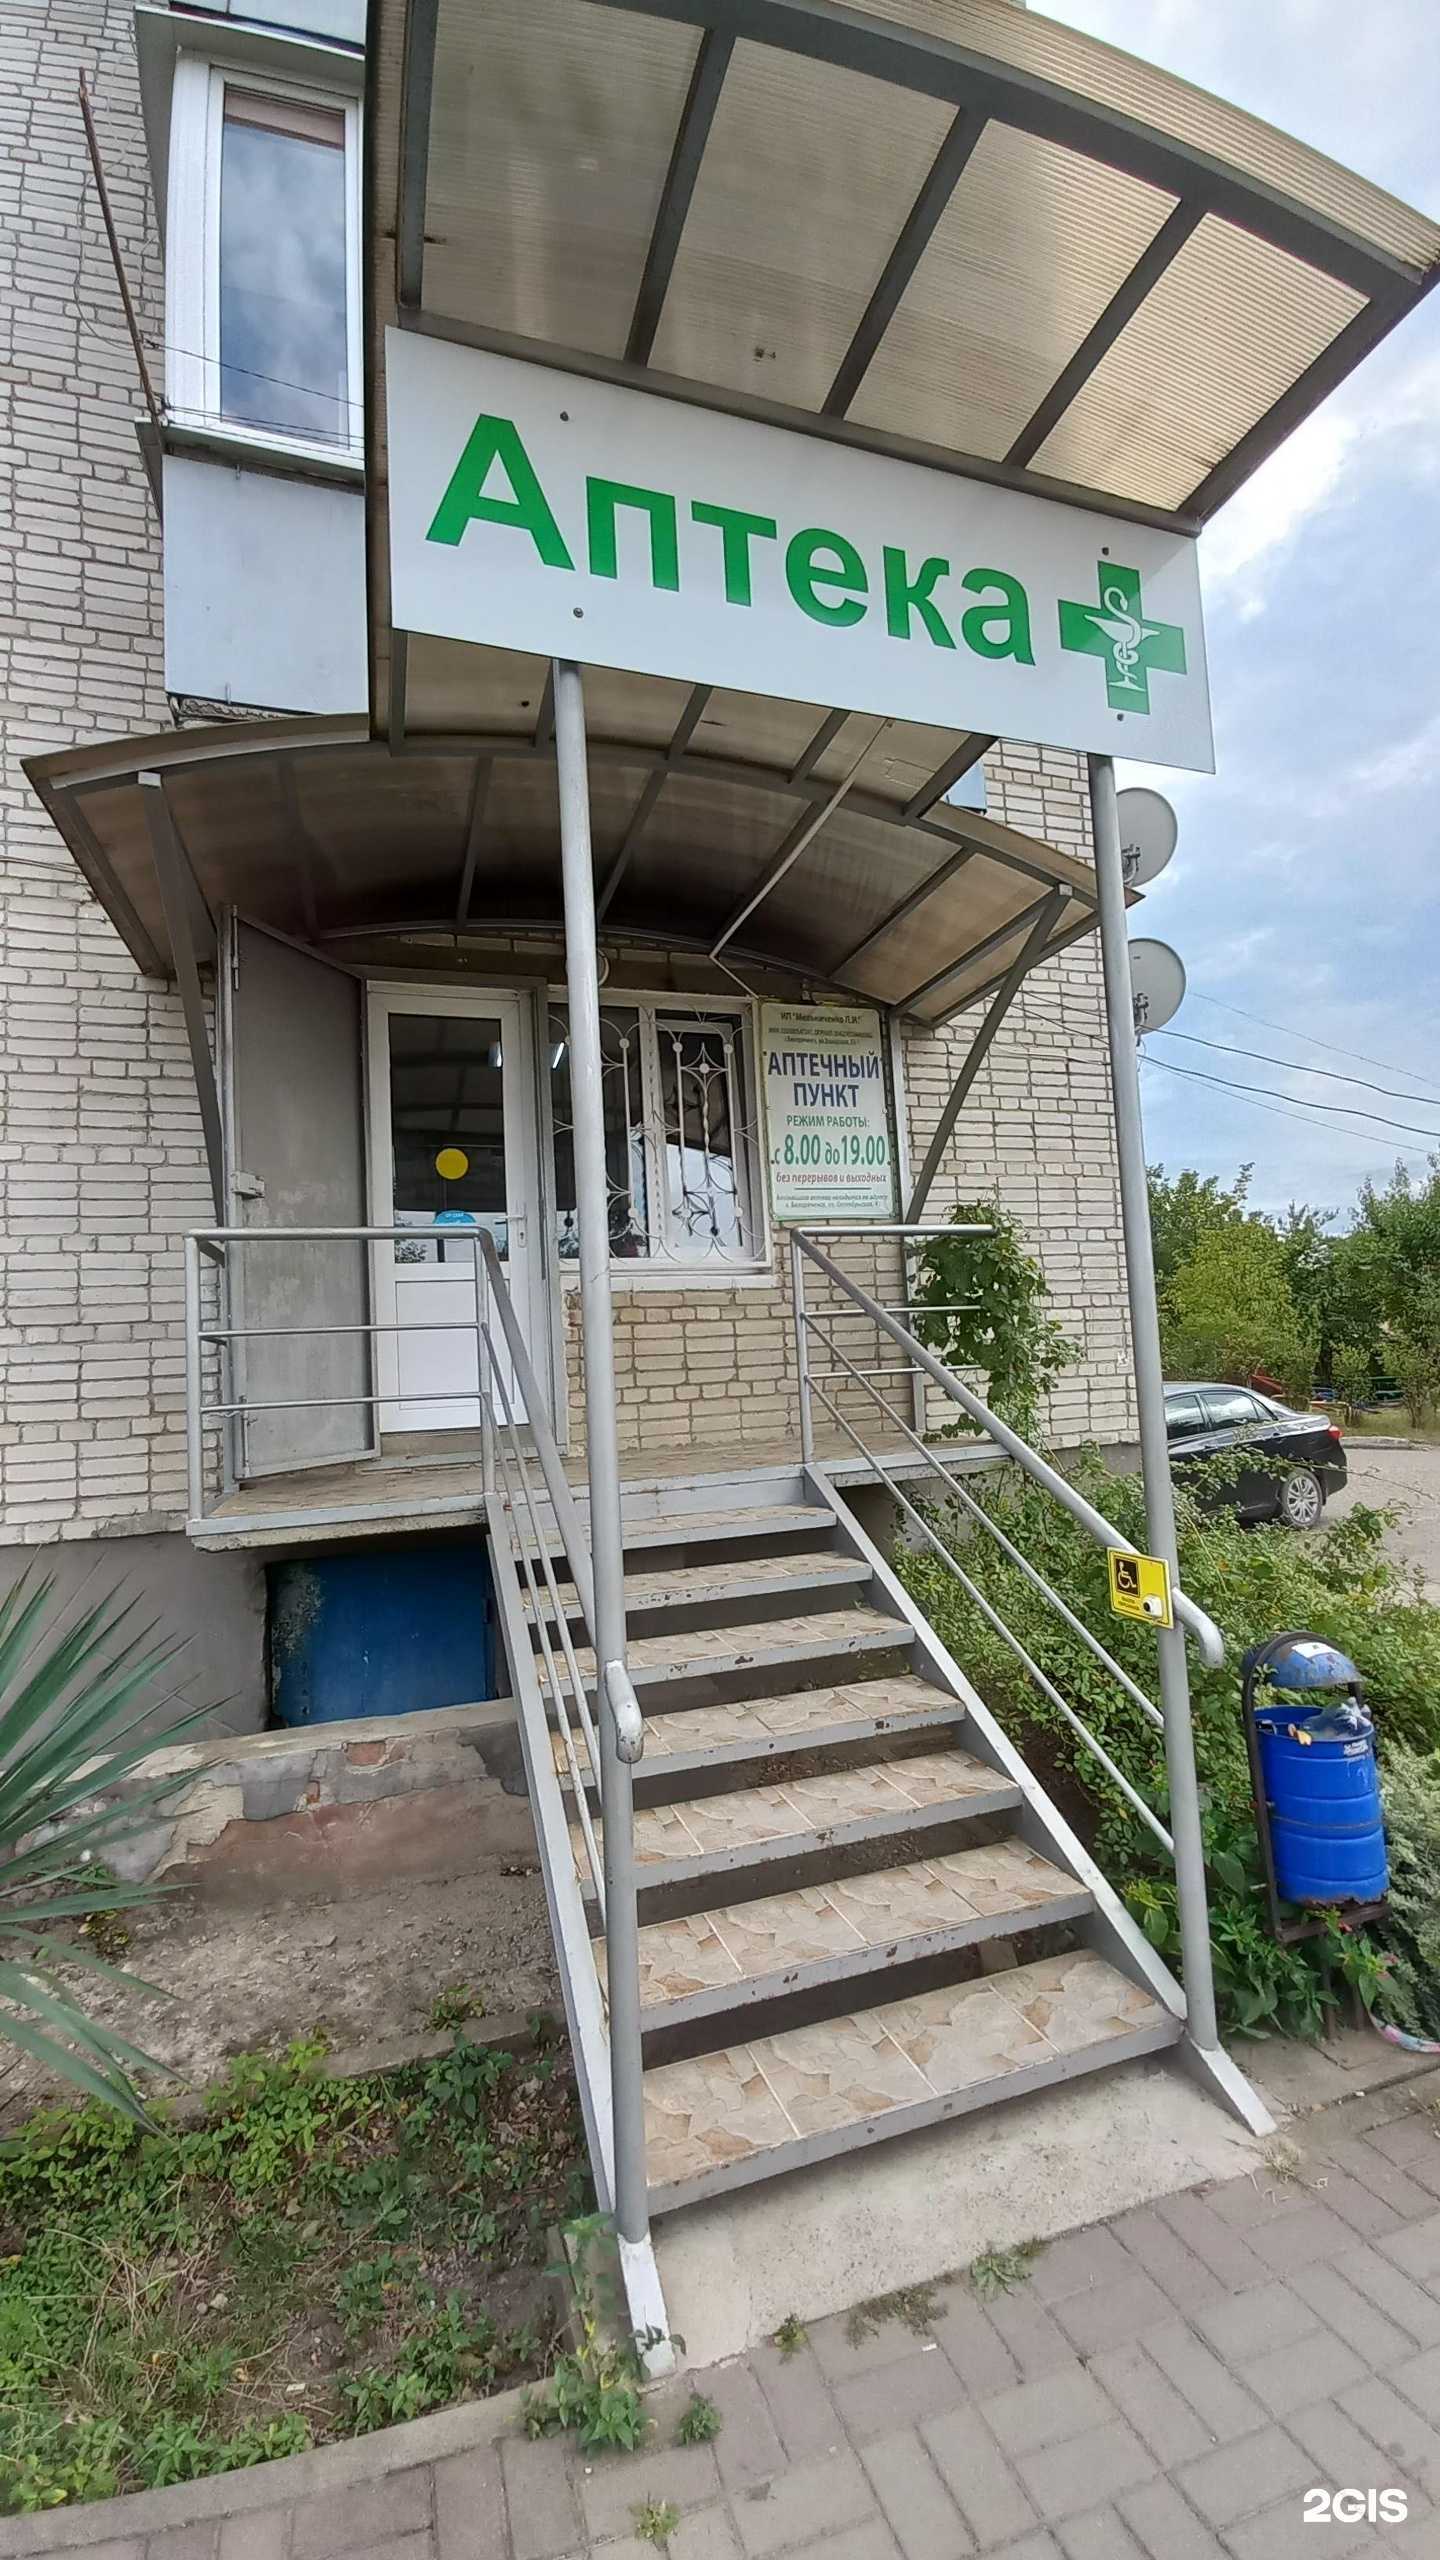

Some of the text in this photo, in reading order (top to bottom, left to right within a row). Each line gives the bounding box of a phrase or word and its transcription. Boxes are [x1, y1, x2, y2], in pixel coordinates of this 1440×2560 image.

[426, 413, 1036, 667] Аптека
[768, 1051, 880, 1079] АПТЕЧНЫЙ
[793, 1083, 859, 1108] ПУНКТ
[786, 1115, 870, 1128] РЕЖИМ РАБОТЫ:
[774, 1134, 885, 1165] с 8.00 до 19.00
[776, 1172, 886, 1185] без перерывов и выходных
